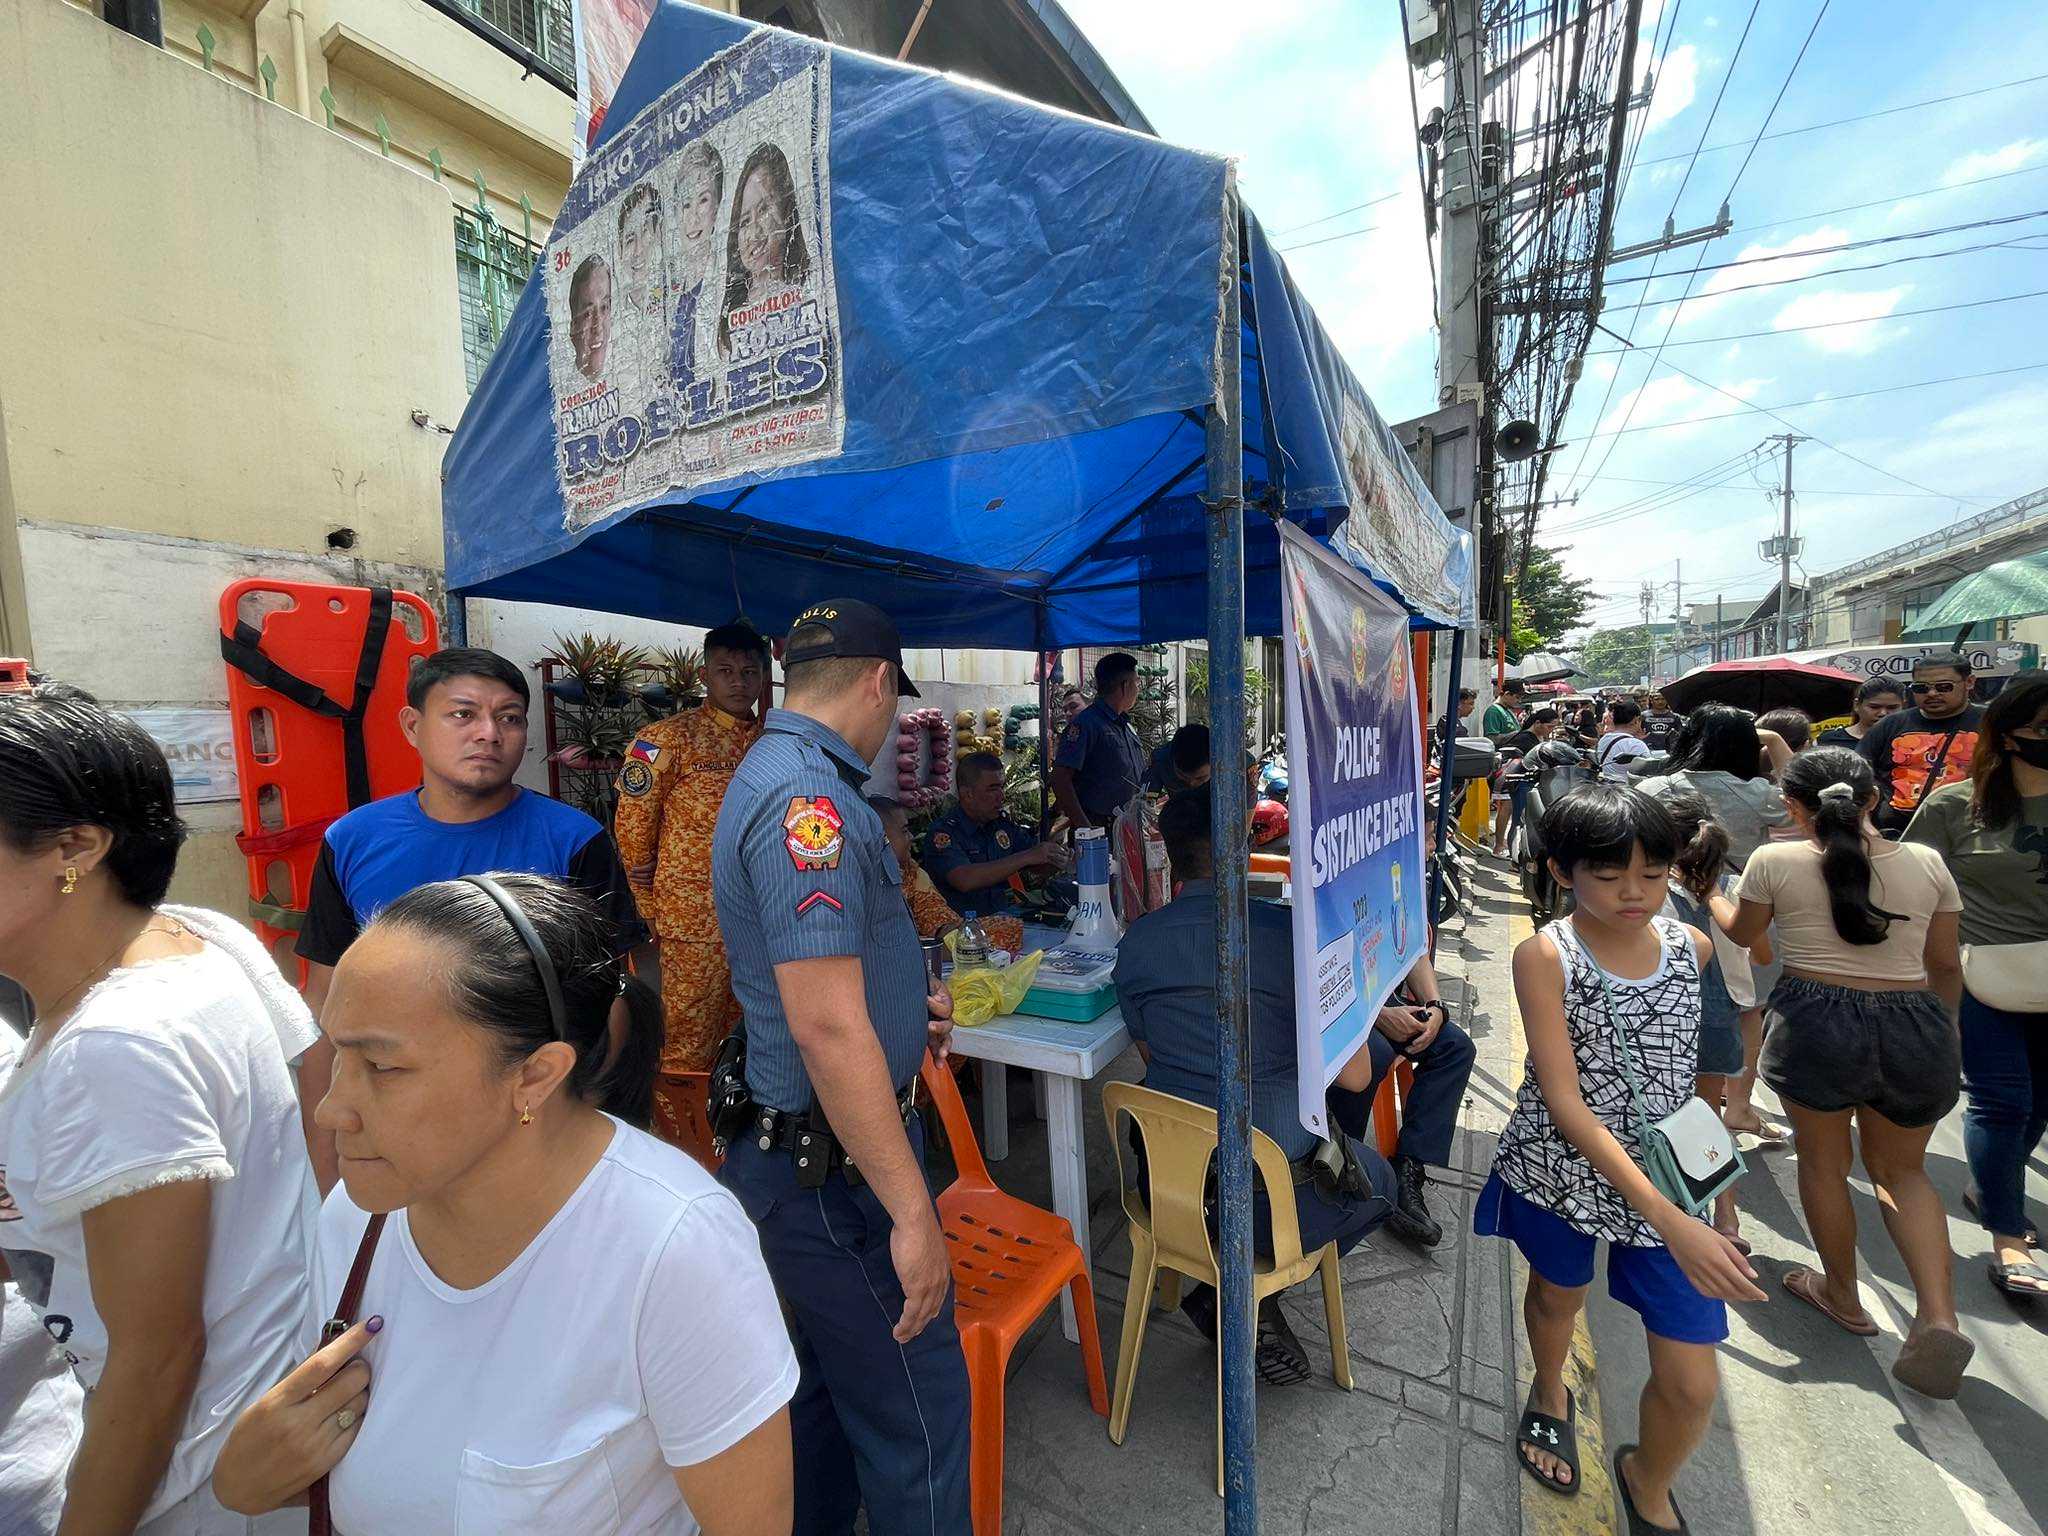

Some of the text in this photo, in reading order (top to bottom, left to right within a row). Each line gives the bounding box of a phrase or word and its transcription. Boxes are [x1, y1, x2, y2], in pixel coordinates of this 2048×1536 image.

[654, 62, 748, 148] HONEY
[560, 388, 620, 437] RAMON
[793, 606, 838, 628] ULIS
[1333, 726, 1381, 784] POLICE
[1312, 791, 1415, 889] SISTANCE DESK
